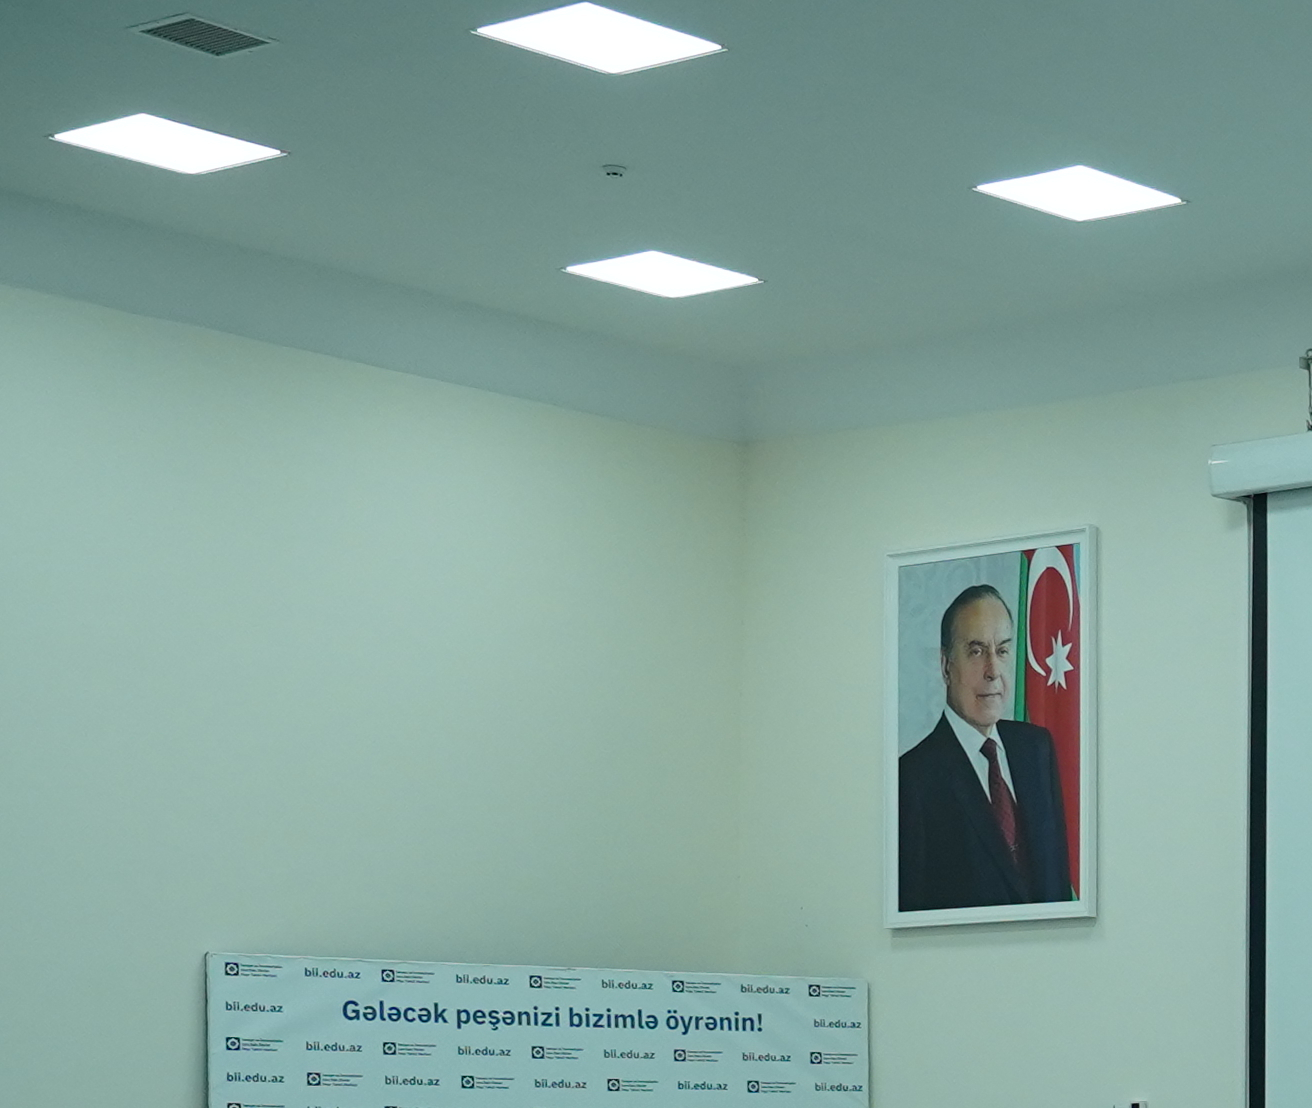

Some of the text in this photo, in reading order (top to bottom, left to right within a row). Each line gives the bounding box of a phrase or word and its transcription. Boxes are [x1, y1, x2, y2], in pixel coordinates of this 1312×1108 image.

[303, 966, 361, 980] bii.edu.az
[455, 973, 510, 986] bii.edu.az
[600, 979, 654, 991] bii.edu.az
[739, 983, 791, 995] bii.edu.az
[224, 1000, 284, 1014] bii.edu.az
[341, 999, 764, 1036] Gələcək peşənizi bizimlə öyrənin!
[813, 1018, 862, 1029] bii.edu.az
[305, 1040, 363, 1053] bii.edu.az
[457, 1045, 512, 1057] bii.edu.az
[603, 1048, 656, 1060] bii.edu.az
[741, 1051, 792, 1063] bii.edu.az
[225, 1071, 285, 1084] bii.edu.az
[384, 1075, 441, 1087] bii.edu.az
[533, 1078, 588, 1090] bii.edu.az
[677, 1080, 729, 1091] bii.edu.az
[814, 1082, 864, 1093] bii.edu.az
